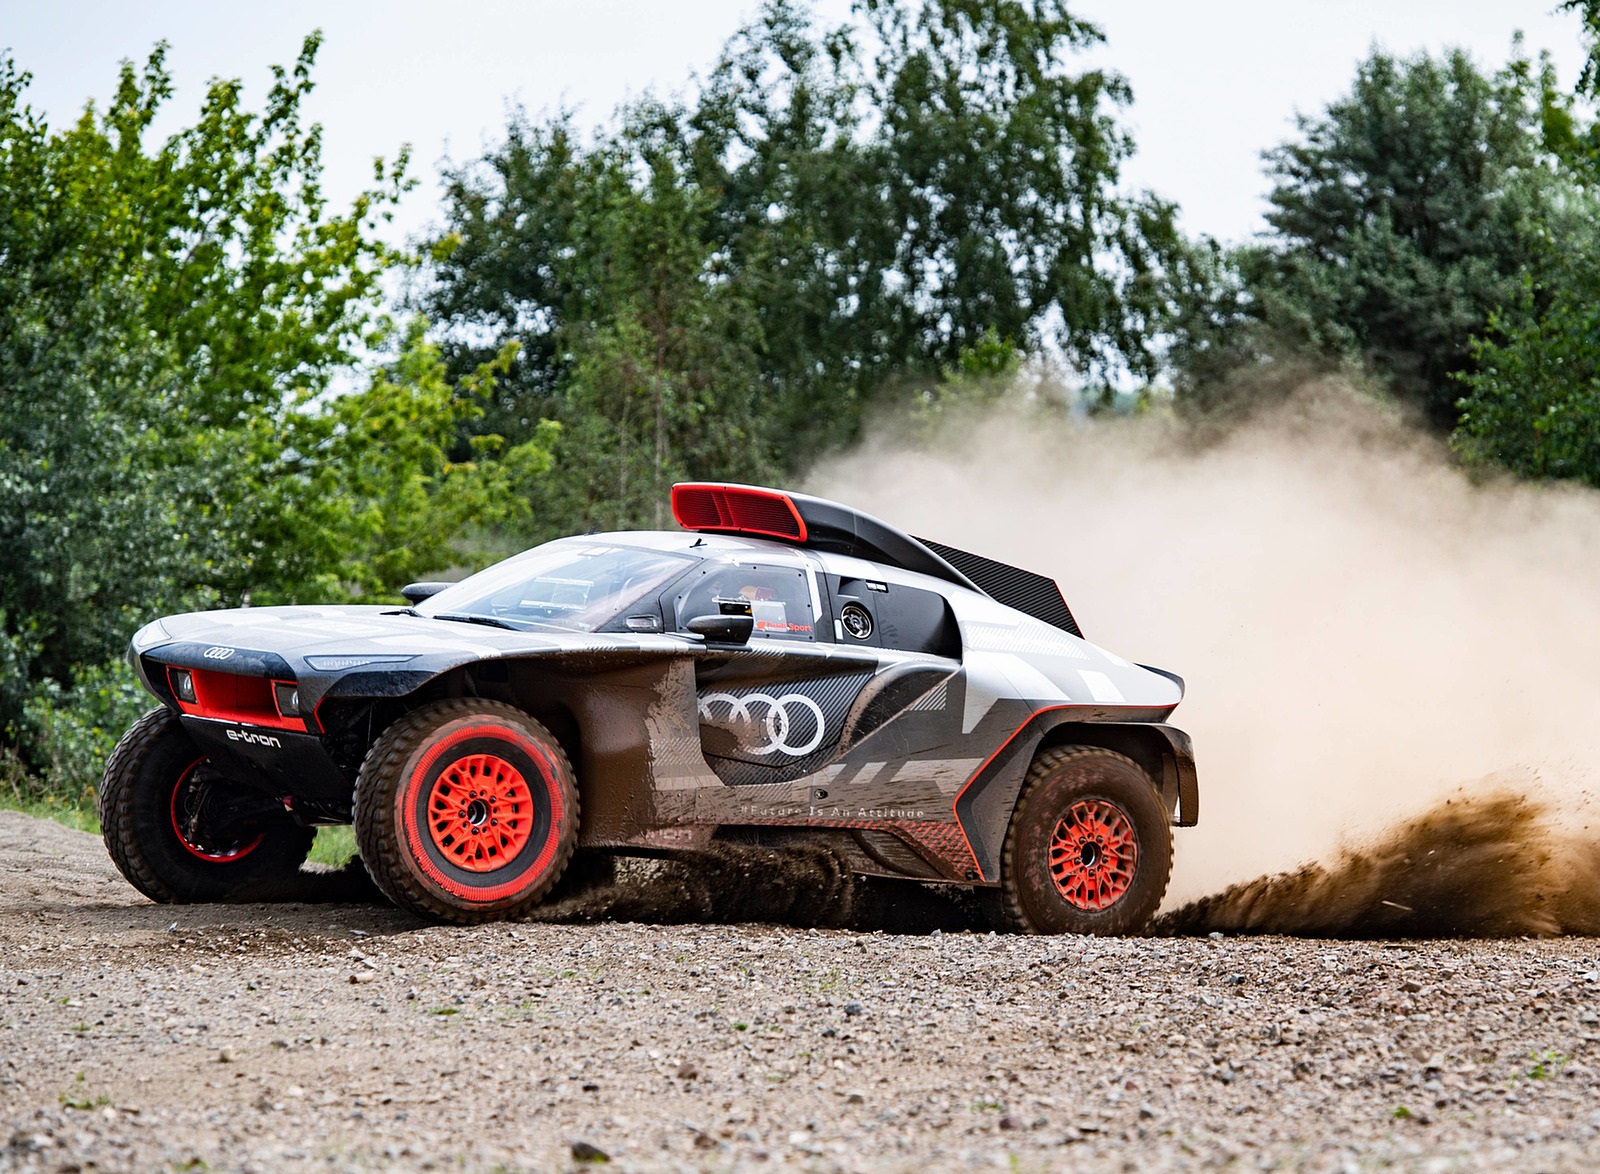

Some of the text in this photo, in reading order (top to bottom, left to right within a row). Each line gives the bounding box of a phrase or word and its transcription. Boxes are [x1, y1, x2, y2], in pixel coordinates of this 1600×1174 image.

[788, 622, 813, 632] Sport
[226, 729, 281, 748] e-tron
[809, 806, 824, 816] Is
[830, 807, 850, 817] An
[858, 807, 924, 818] Attitude
